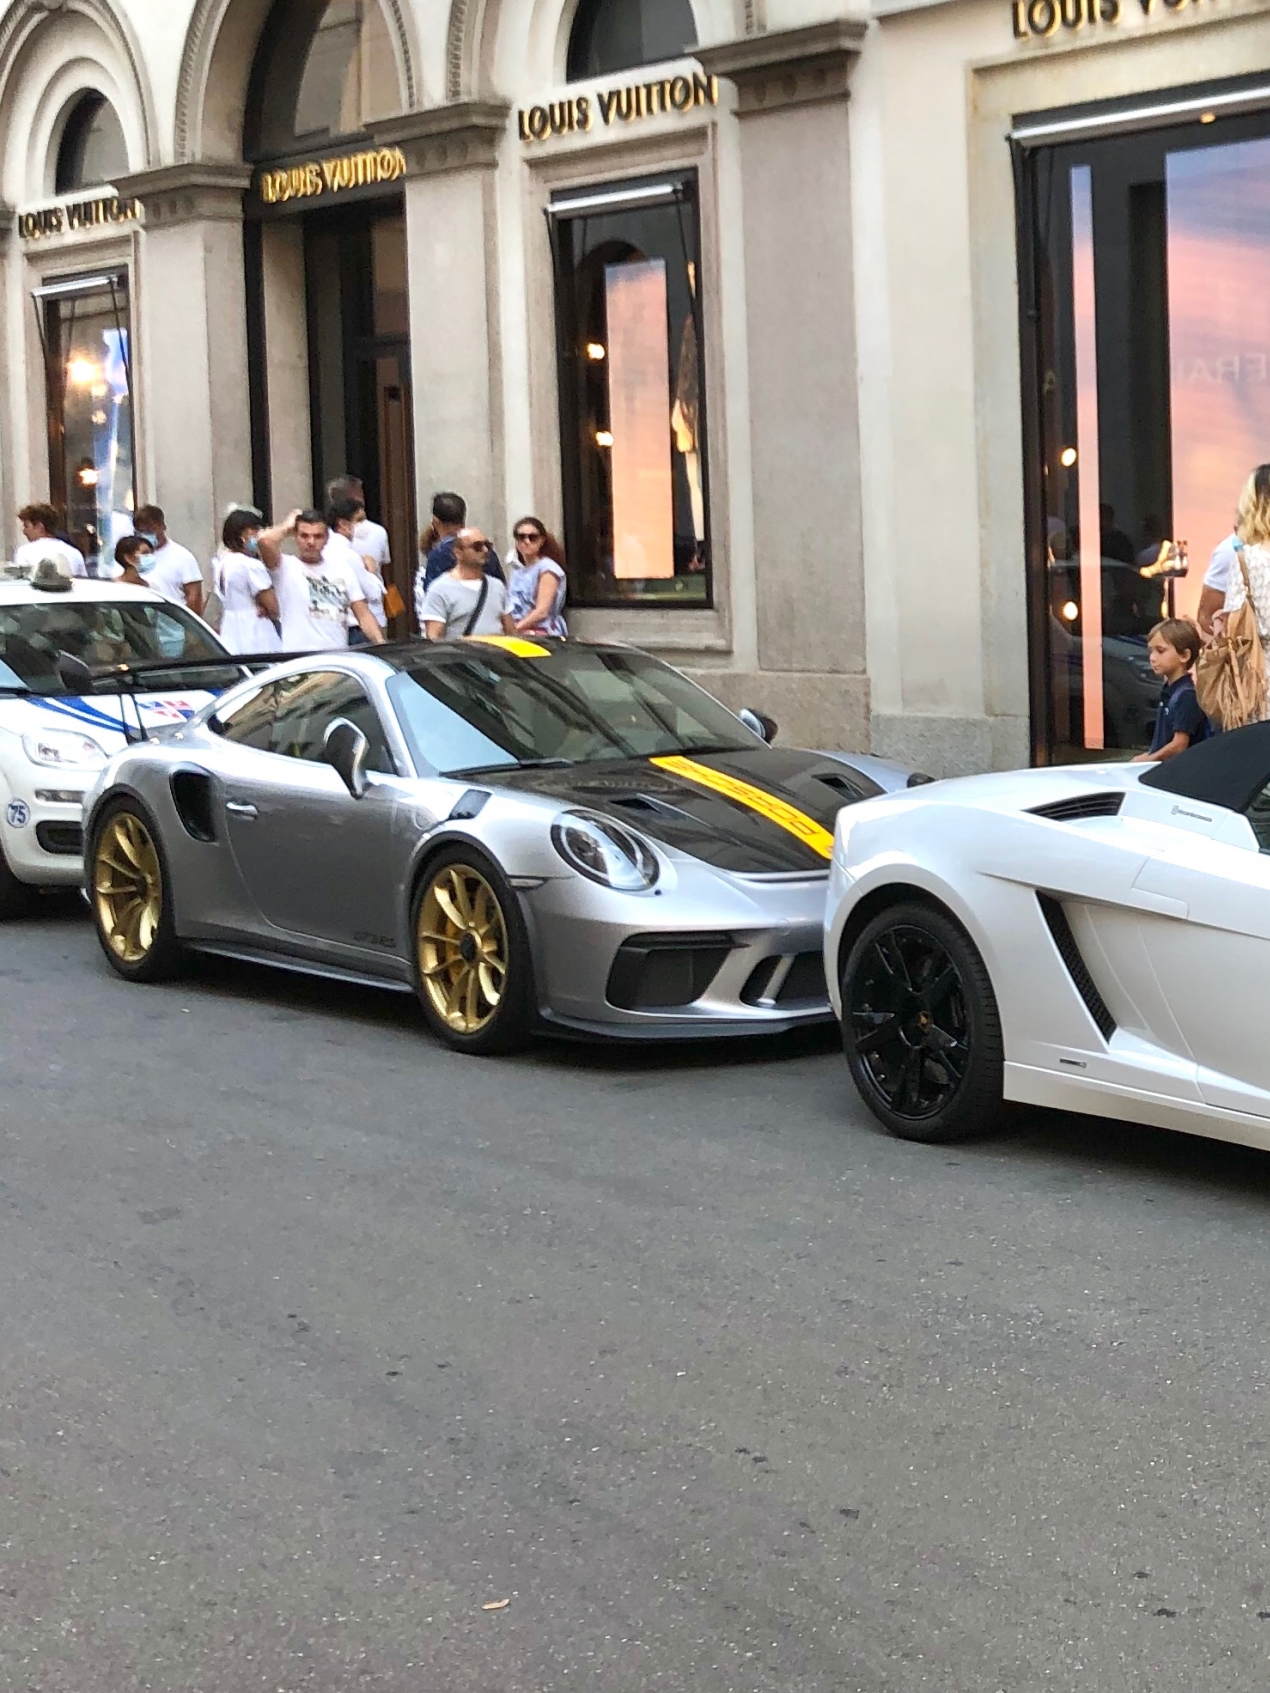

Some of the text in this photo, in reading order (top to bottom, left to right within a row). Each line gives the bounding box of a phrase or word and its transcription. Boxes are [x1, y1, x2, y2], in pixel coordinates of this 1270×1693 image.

[517, 72, 719, 143] LOUIS VUITTON
[262, 162, 322, 203] LOUIS
[18, 206, 65, 238] LOUIS
[8, 803, 26, 823] 75
